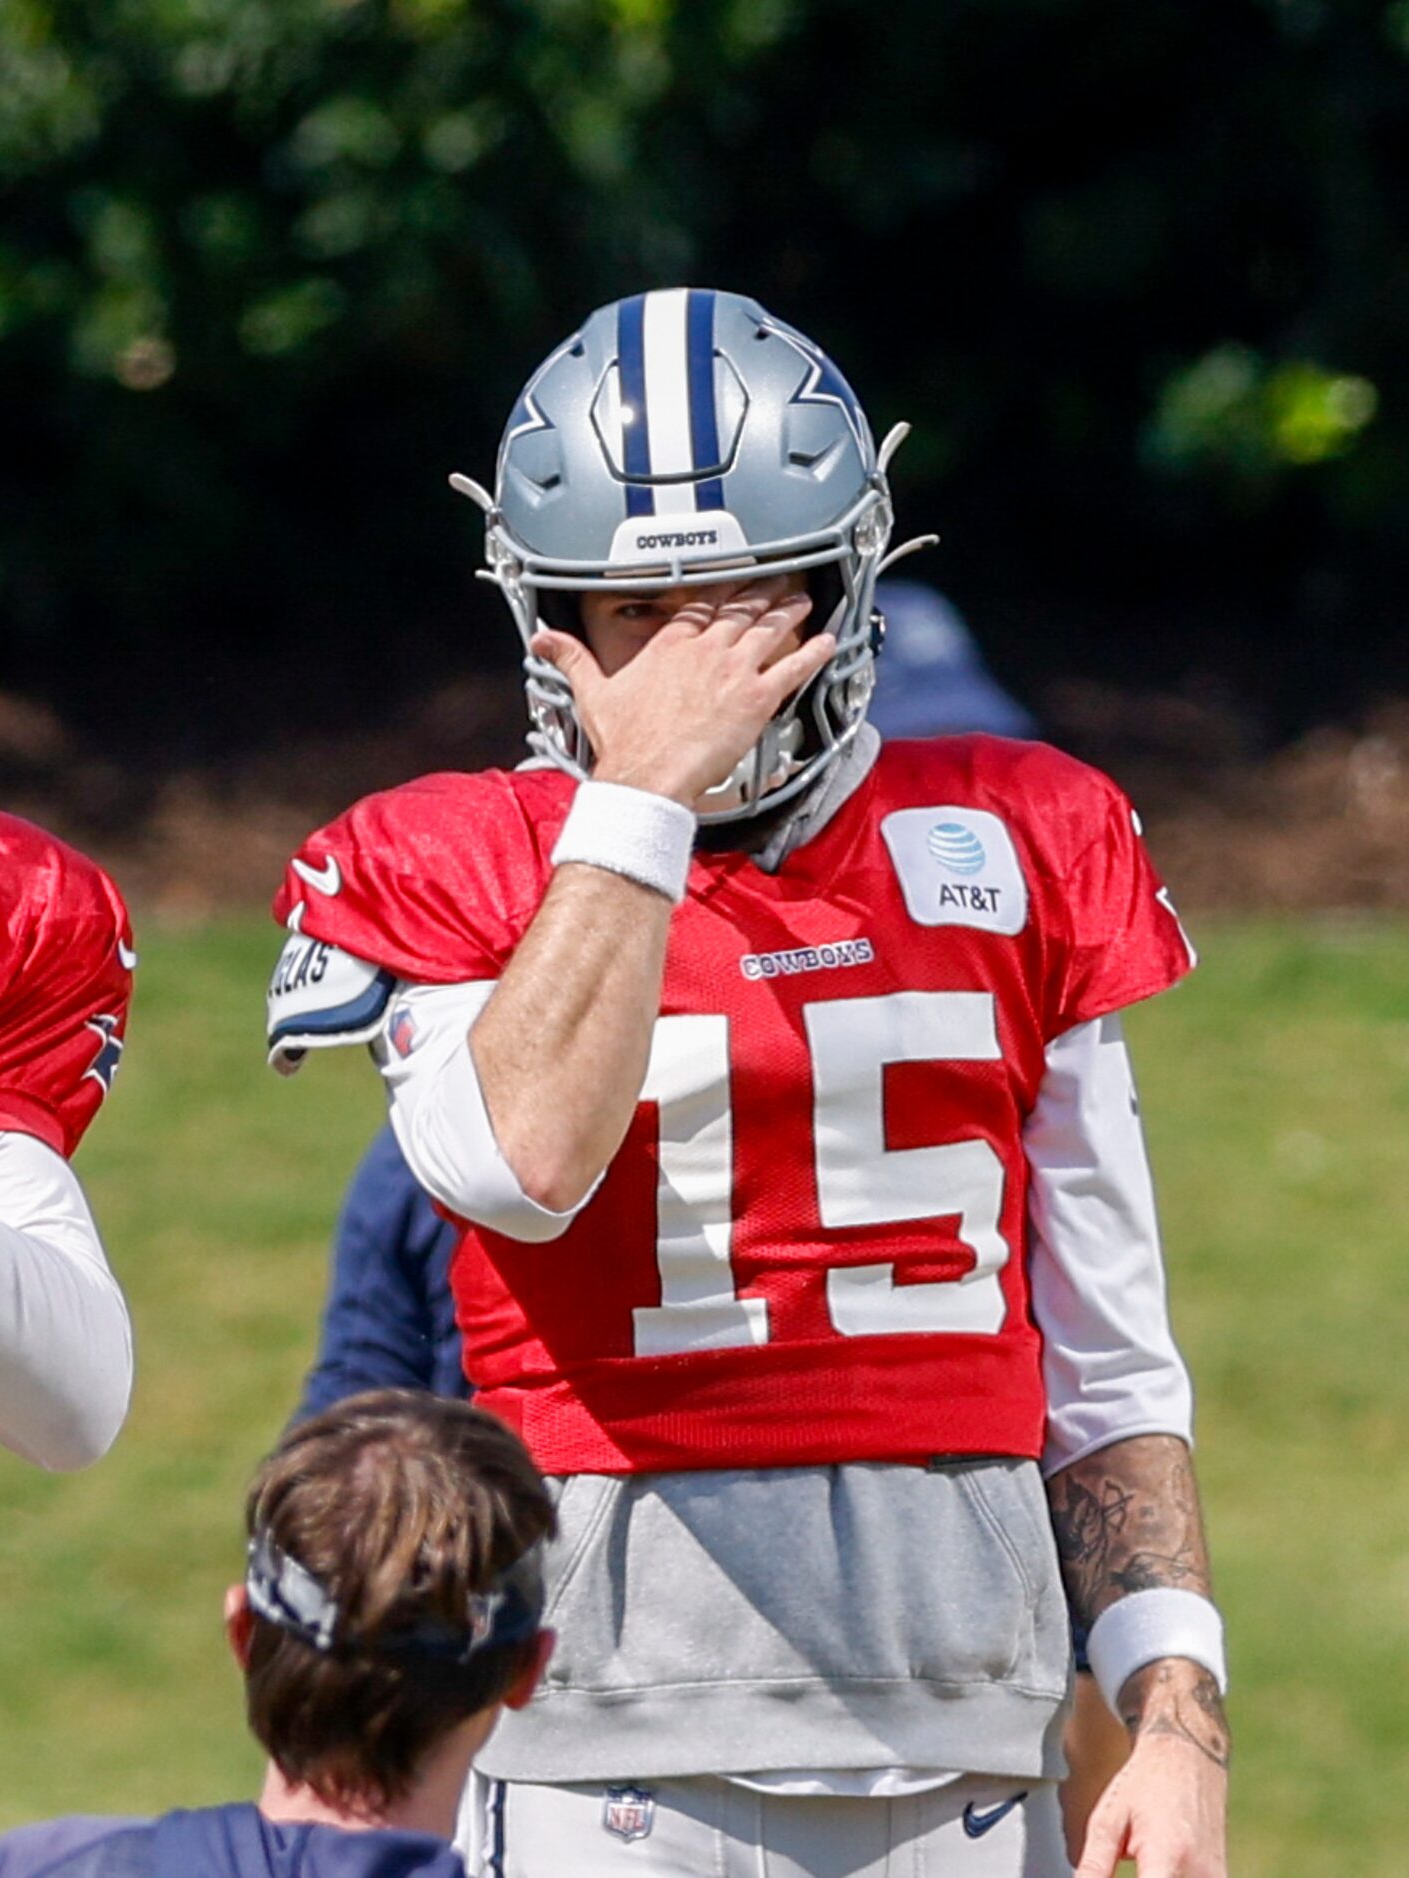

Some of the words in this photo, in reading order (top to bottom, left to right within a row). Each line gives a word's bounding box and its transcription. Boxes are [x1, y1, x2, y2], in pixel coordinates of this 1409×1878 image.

[636, 530, 718, 549] COWBOYS
[939, 883, 1002, 913] AT&T
[741, 939, 873, 979] COWBOYS
[631, 990, 1010, 1358] 15
